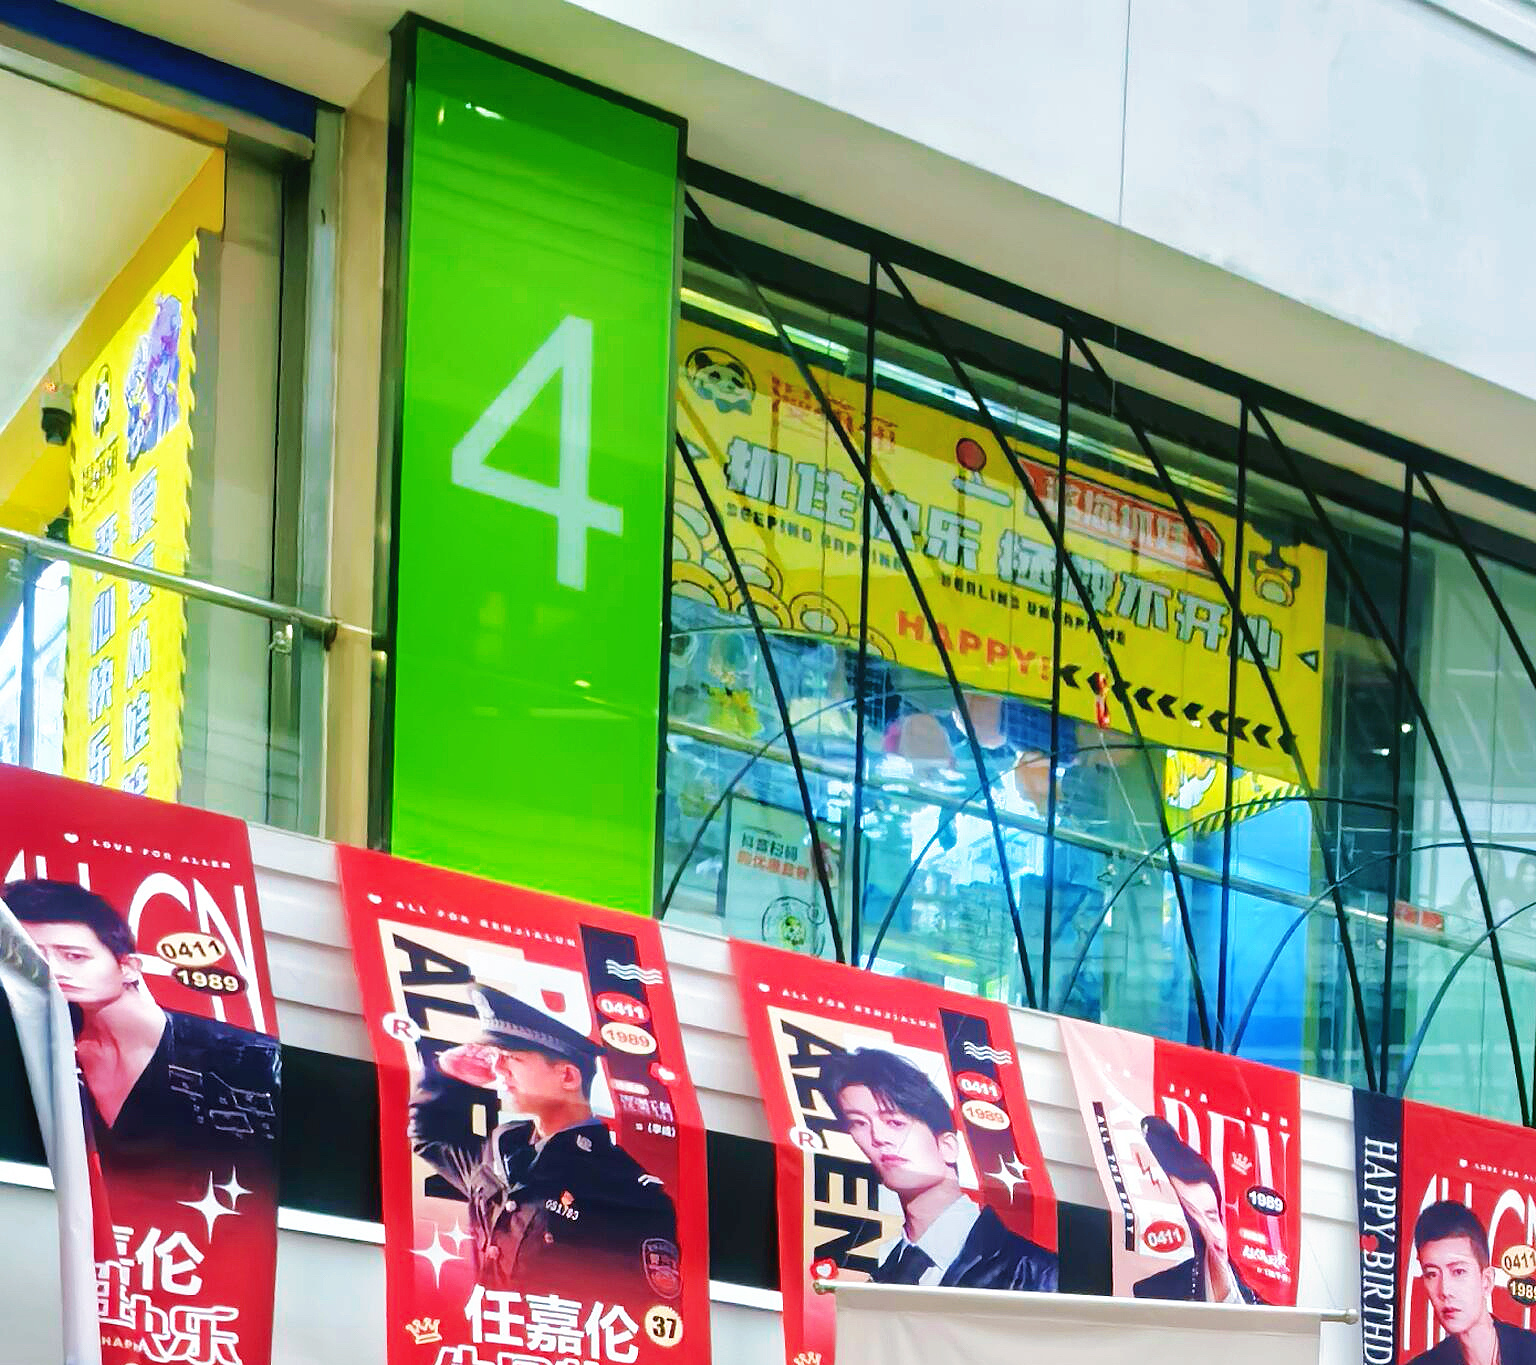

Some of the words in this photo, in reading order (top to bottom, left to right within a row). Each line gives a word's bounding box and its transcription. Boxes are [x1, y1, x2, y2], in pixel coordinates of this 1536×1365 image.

[451, 314, 624, 591] 4
[92, 838, 133, 854] LOVE
[142, 848, 173, 861] FOR
[181, 855, 232, 869] ALLEN
[161, 938, 223, 961] 0411
[177, 969, 239, 992] 1989
[600, 998, 644, 1018] 0411
[391, 1018, 412, 1040] R
[605, 1028, 650, 1048] 1989
[961, 1076, 1000, 1098] 0411
[964, 1103, 1005, 1125] 1989
[1363, 1135, 1398, 1240] HAPPY
[1249, 1189, 1284, 1212] 1989
[1147, 1228, 1182, 1247] 0411
[466, 1285, 639, 1365] 任嘉伦
[651, 1314, 678, 1340] 37
